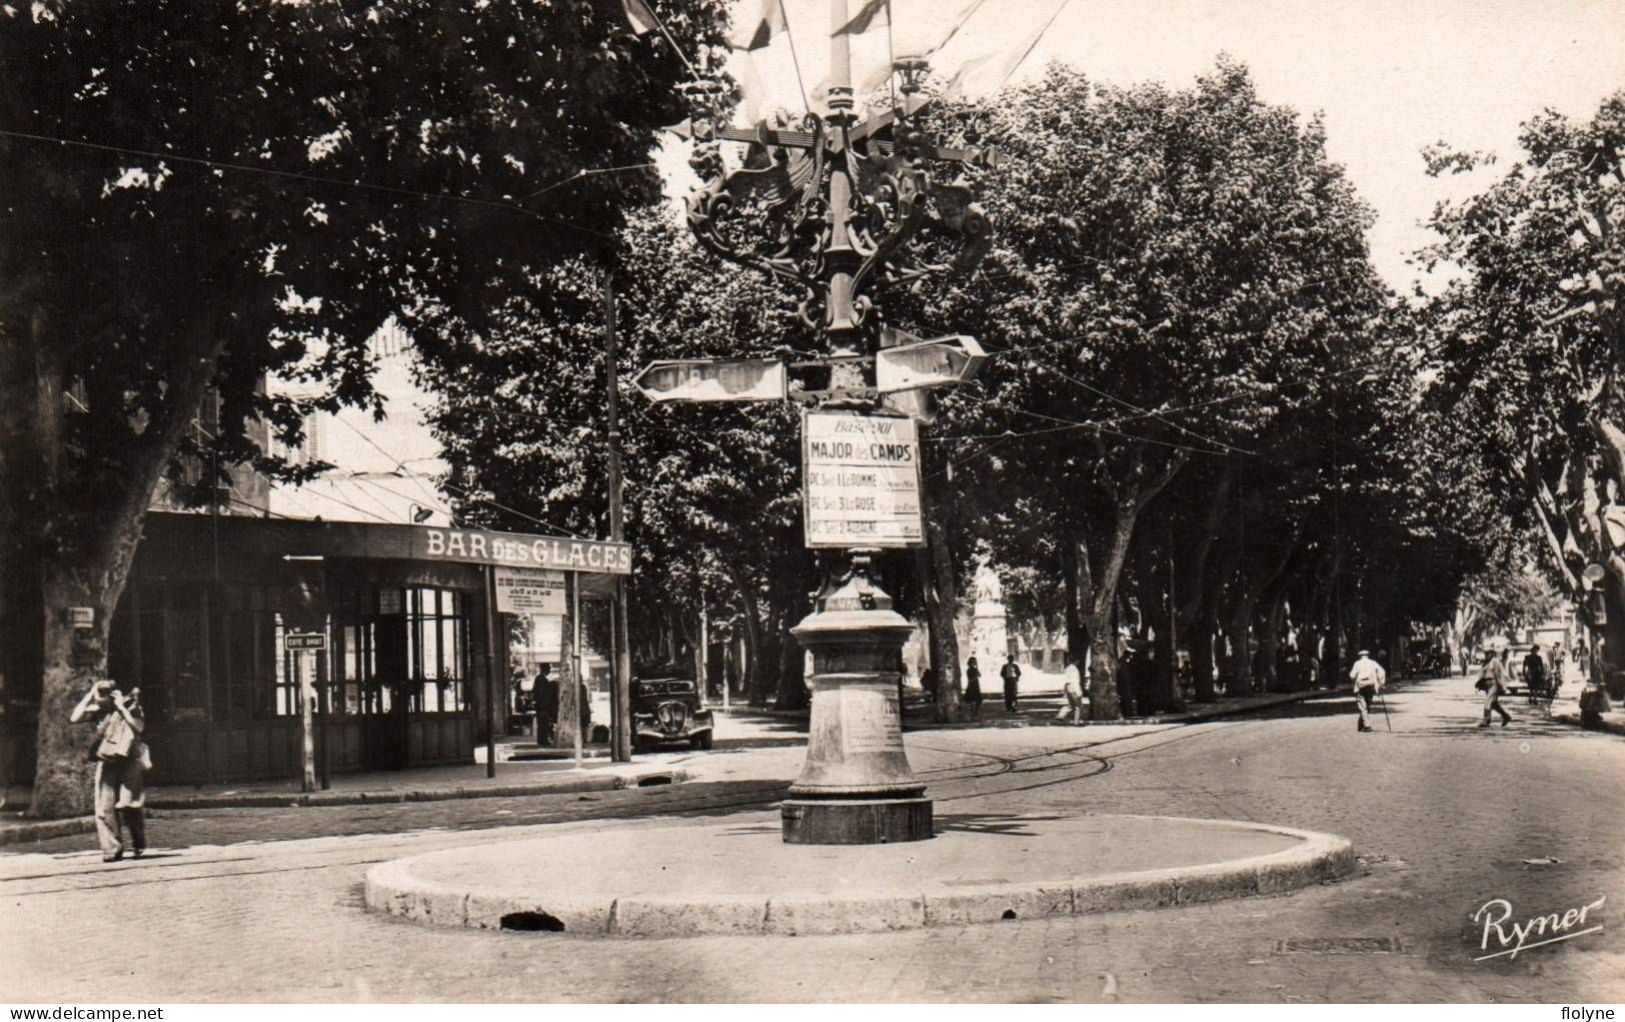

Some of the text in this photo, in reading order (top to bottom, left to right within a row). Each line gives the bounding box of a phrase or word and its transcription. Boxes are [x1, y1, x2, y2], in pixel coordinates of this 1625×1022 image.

[810, 442, 853, 459] MAJOR
[870, 443, 912, 462] CAMPS
[427, 530, 631, 569] BAR DES GLACES
